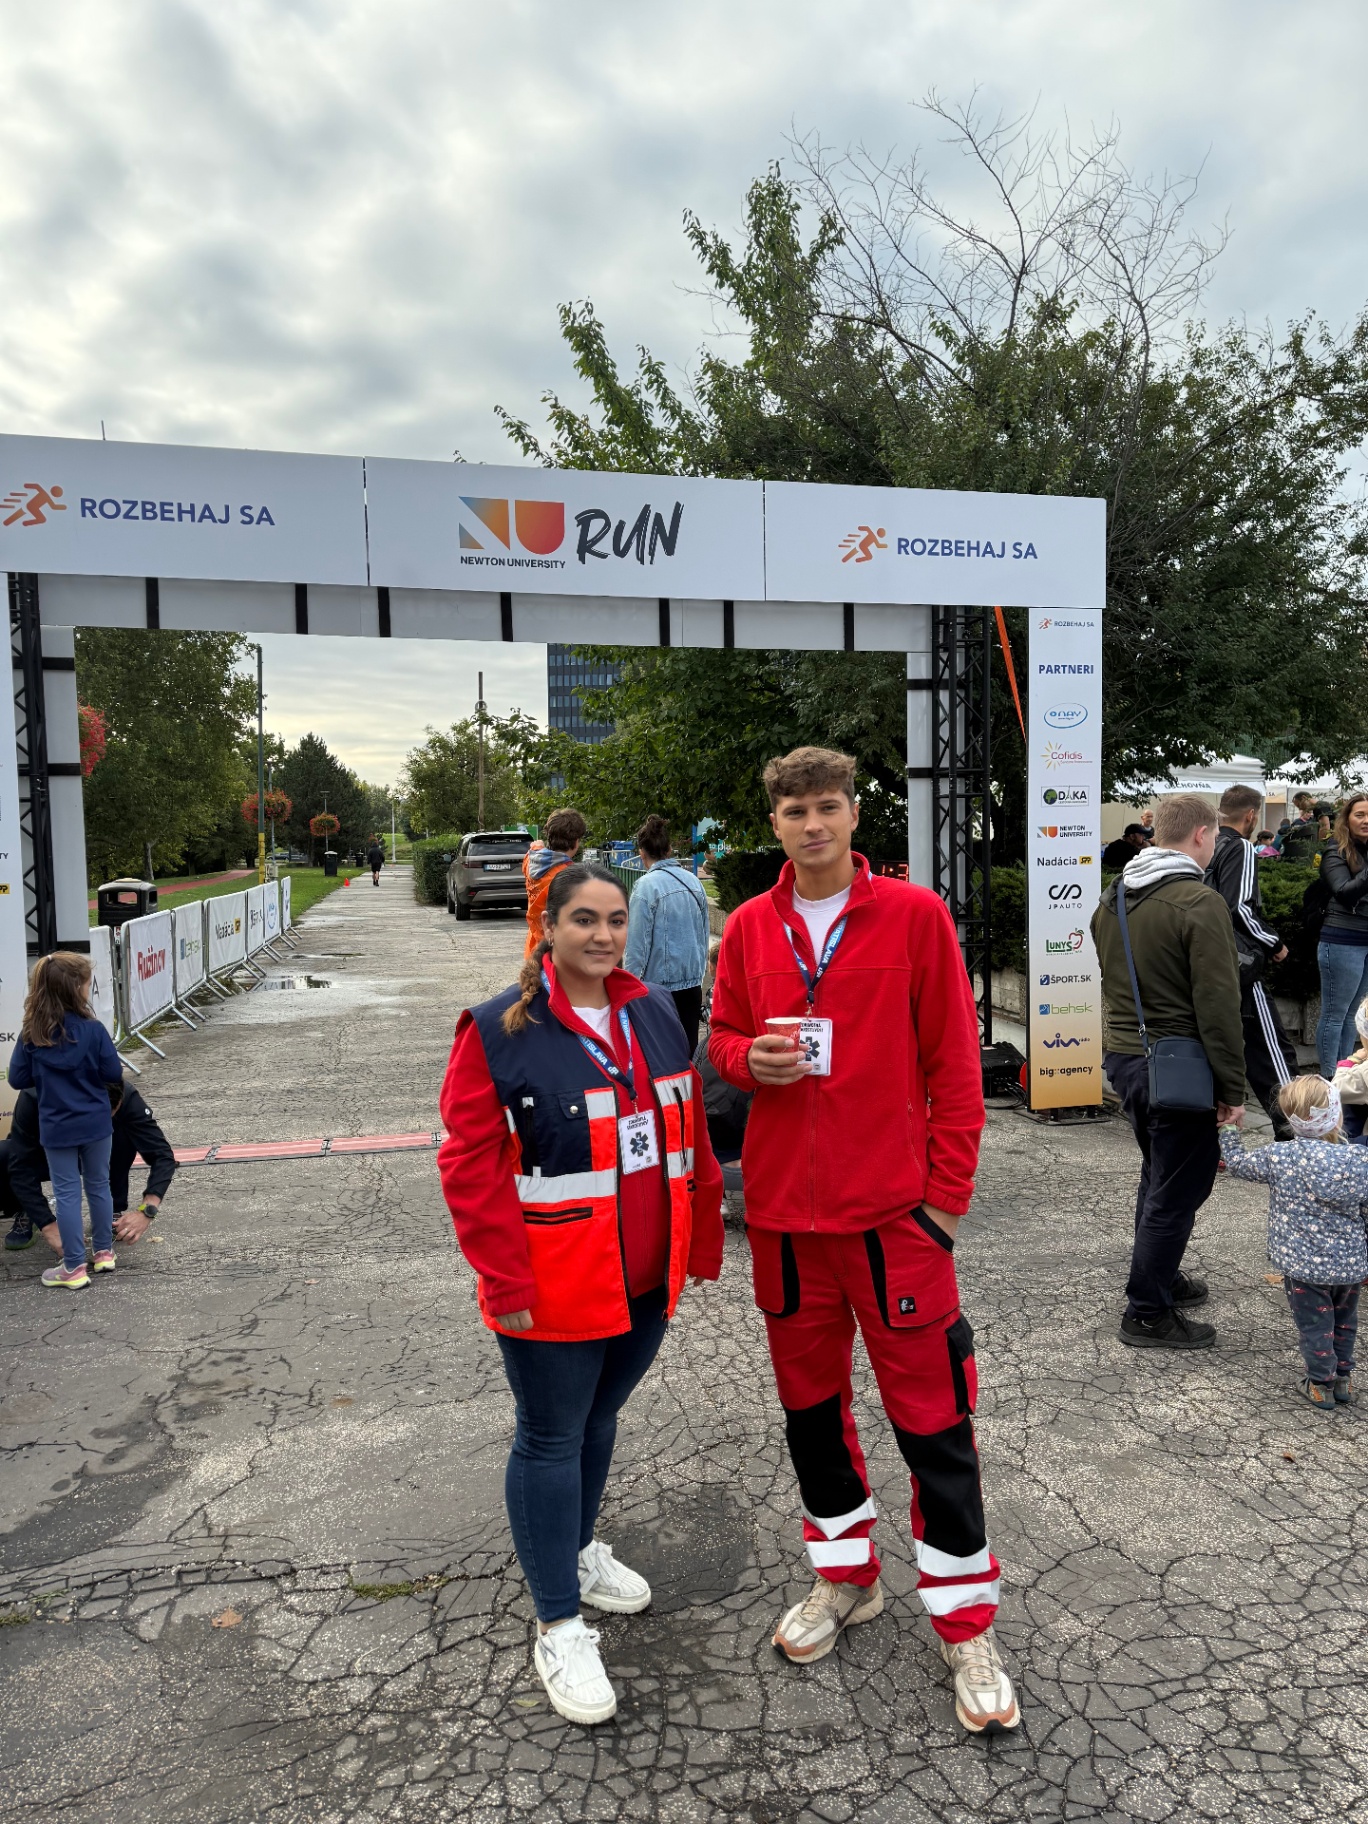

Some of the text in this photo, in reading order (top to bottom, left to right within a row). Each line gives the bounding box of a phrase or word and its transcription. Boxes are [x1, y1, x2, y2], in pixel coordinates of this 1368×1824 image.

[80, 497, 276, 526] ROZBEHAJ SA
[575, 501, 684, 567] RUN
[896, 537, 1039, 560] ROZBEHAJ SA
[460, 555, 566, 569] NEWTON UNIVERSITY
[1054, 620, 1086, 628] ROZBEHAJ
[1039, 664, 1094, 675] PARTNERI
[1051, 750, 1083, 760] Cofidis
[1037, 856, 1078, 867] Nadácia
[1046, 939, 1073, 953] LUNYS
[1050, 974, 1092, 984] ŠPORT.SK
[1051, 1002, 1093, 1015] behsk
